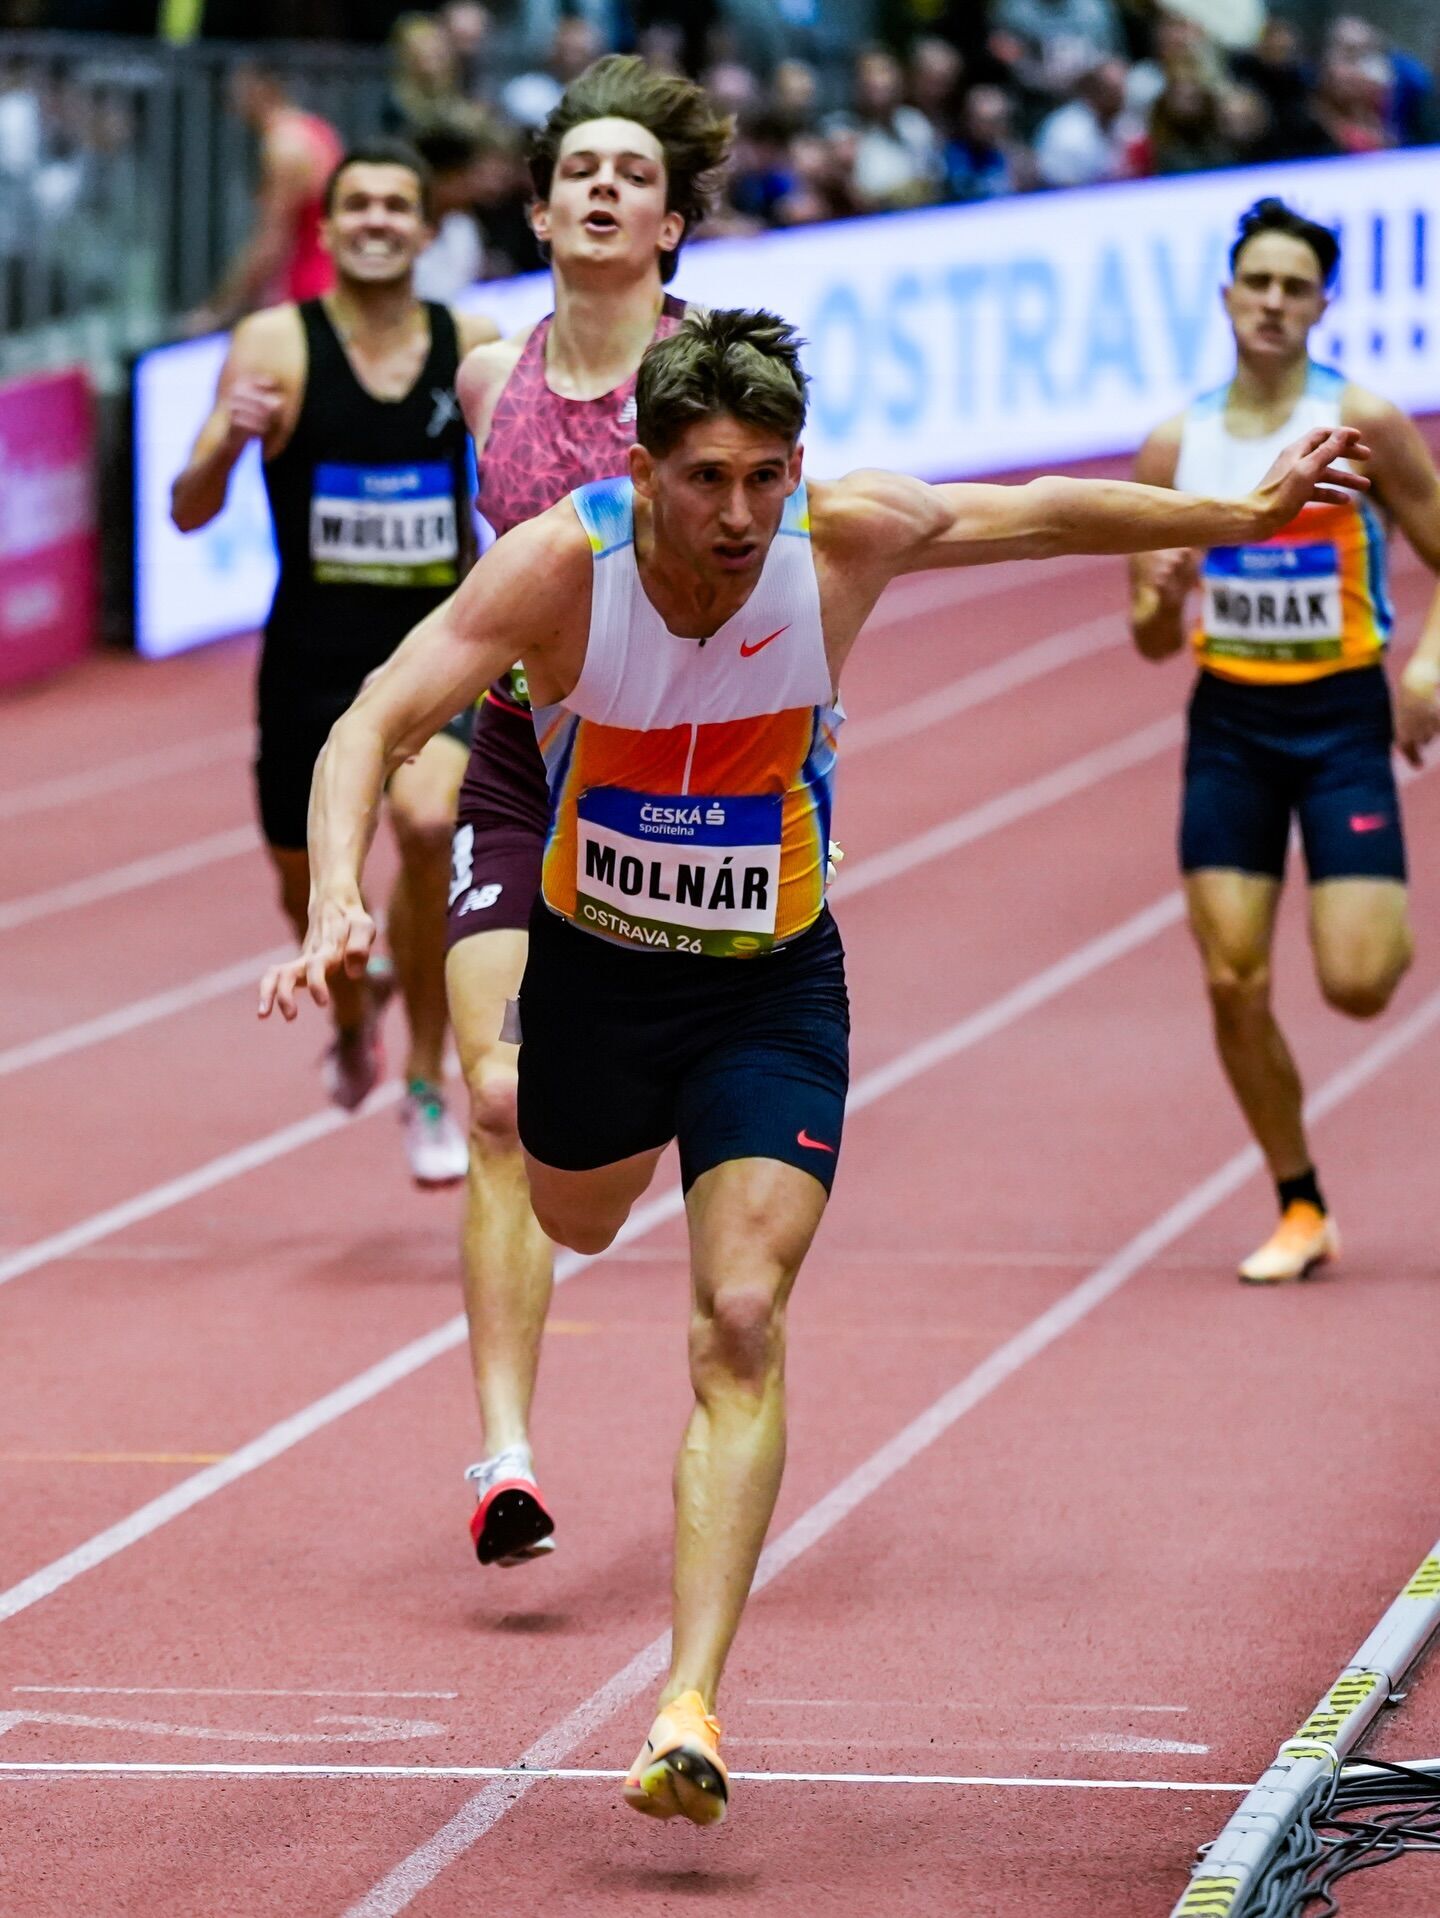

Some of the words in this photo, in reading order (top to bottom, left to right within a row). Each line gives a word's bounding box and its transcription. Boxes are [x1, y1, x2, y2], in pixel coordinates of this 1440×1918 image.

[810, 230, 1222, 440] OSTRAV
[639, 822, 695, 836] spořitelna
[640, 803, 702, 825] ČESKÁ
[585, 838, 769, 911] MOLNÁR
[583, 904, 670, 948] OSTRAVA
[675, 935, 703, 954] 26
